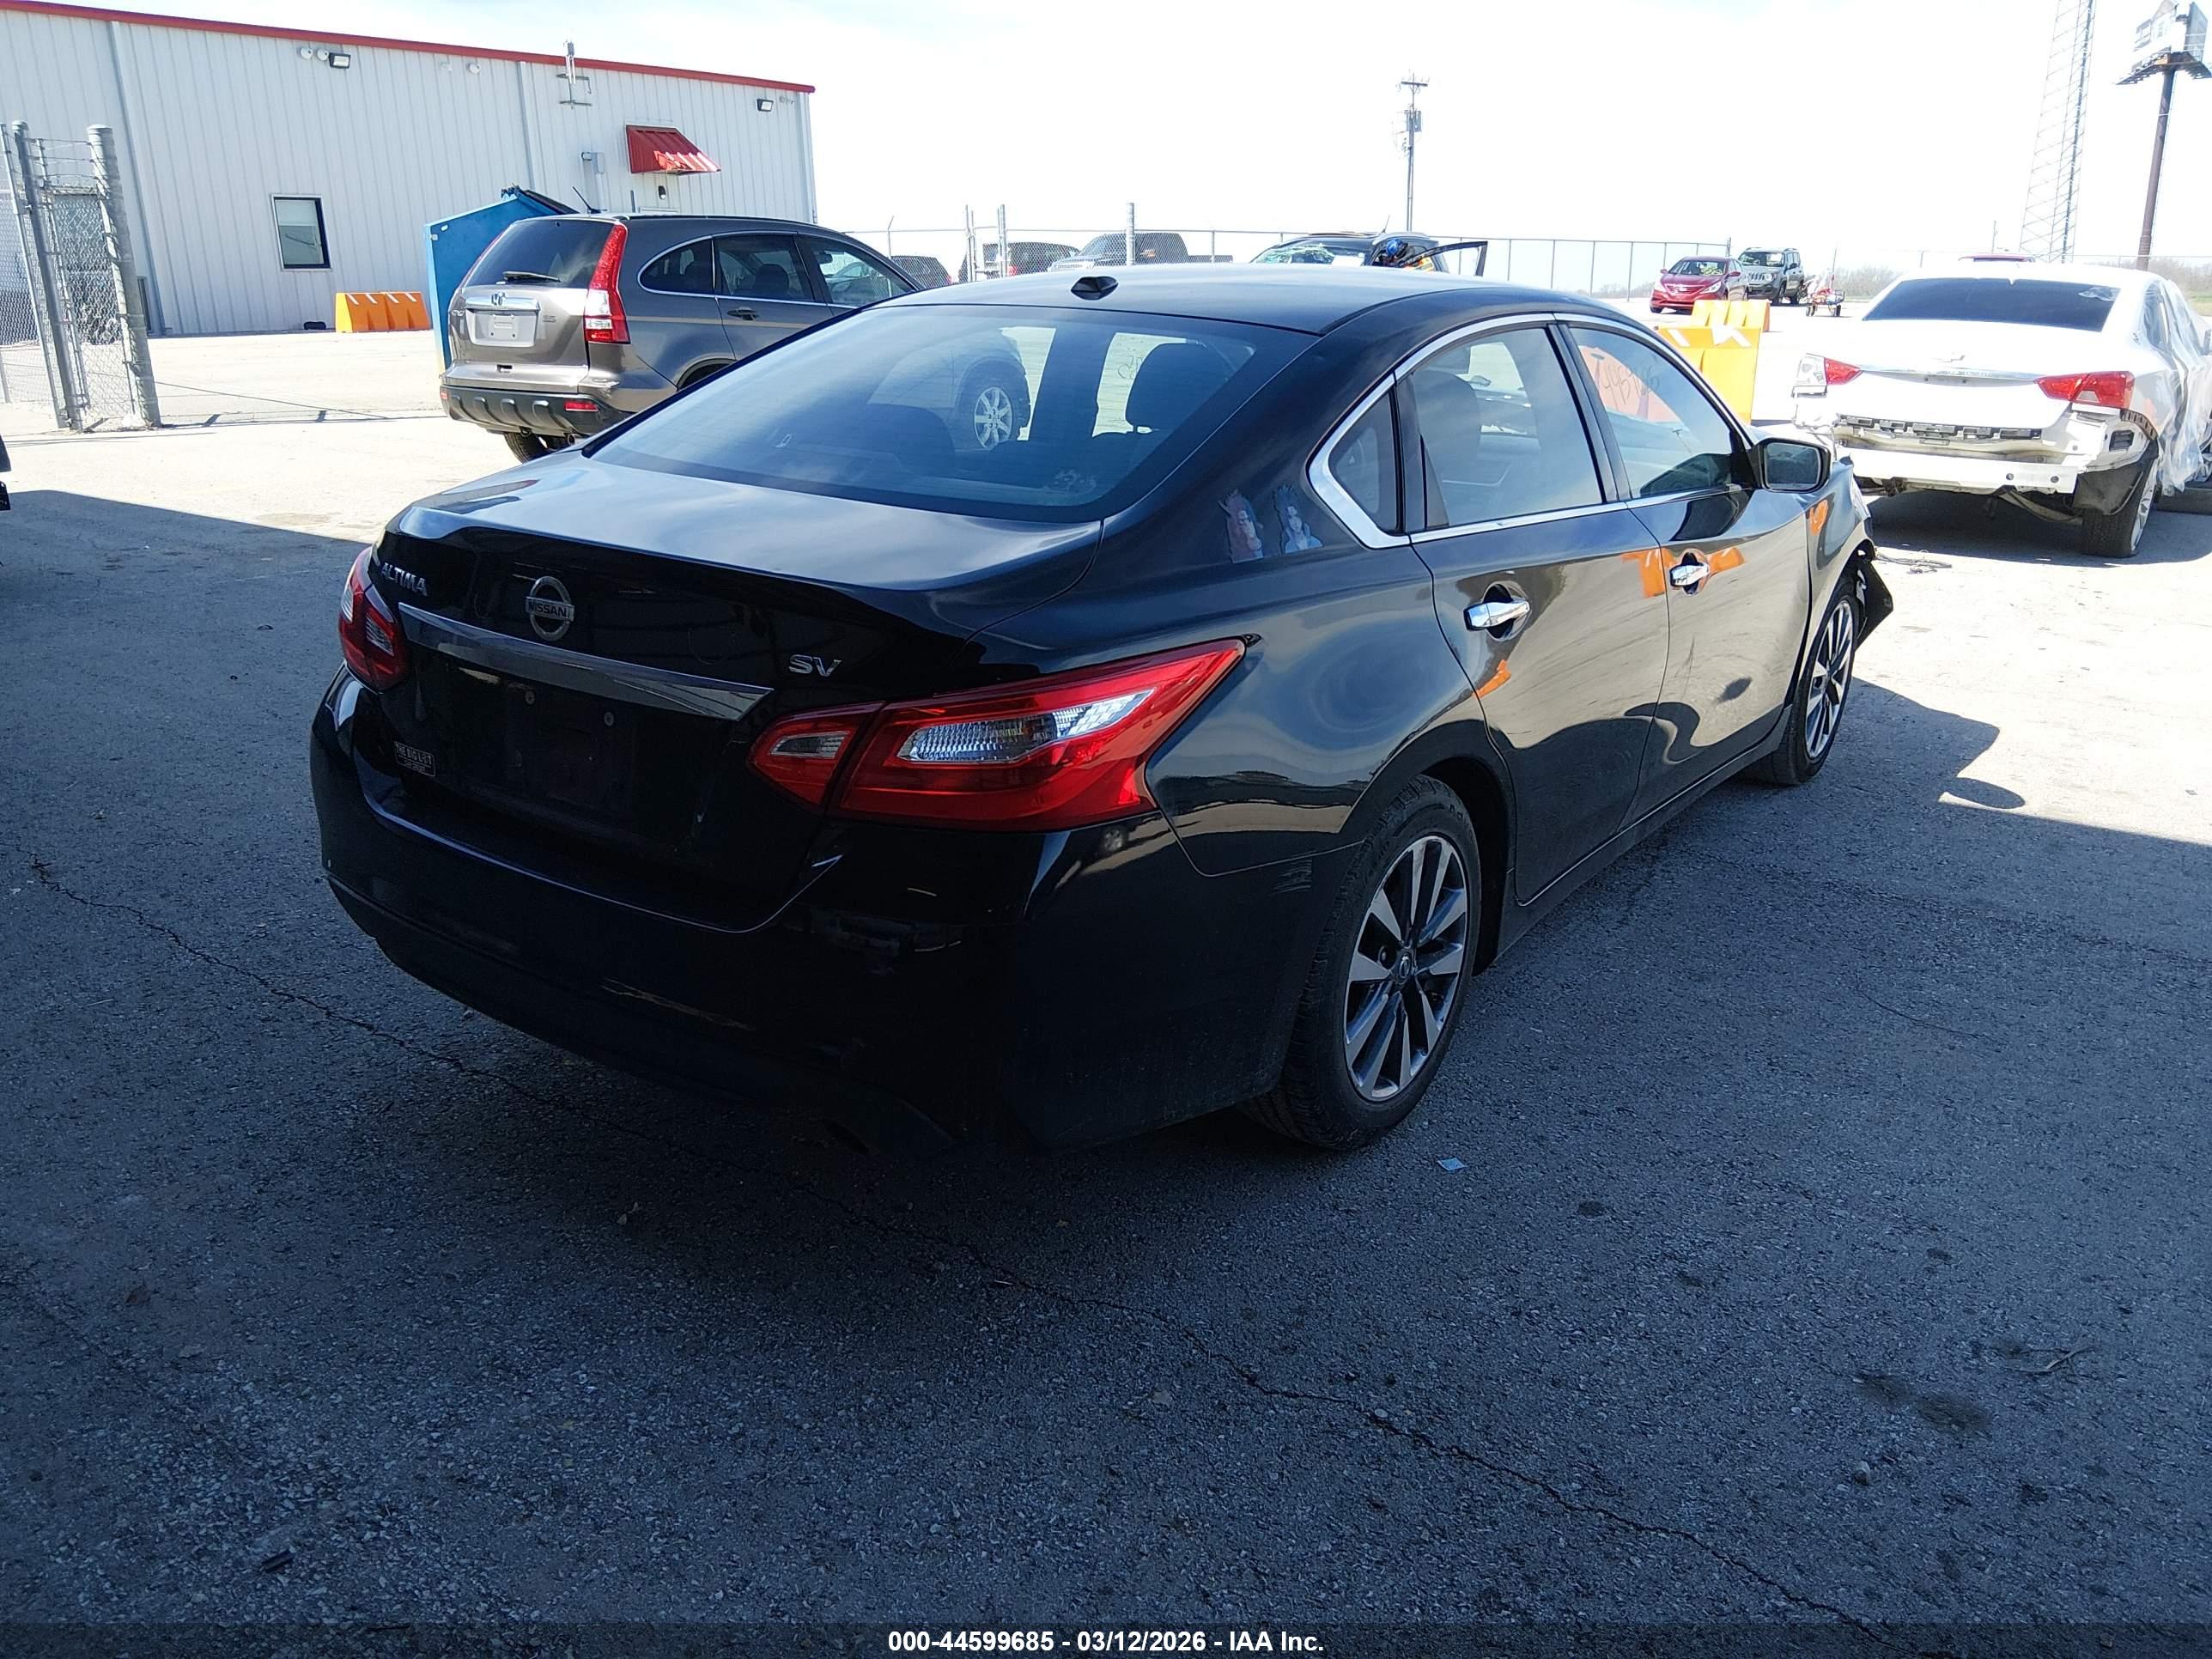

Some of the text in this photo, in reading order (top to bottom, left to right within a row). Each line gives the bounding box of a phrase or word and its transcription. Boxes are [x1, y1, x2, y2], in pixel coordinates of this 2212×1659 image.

[380, 562, 428, 597] ALTIMA
[528, 600, 567, 617] NISSAN
[788, 653, 842, 678] SV
